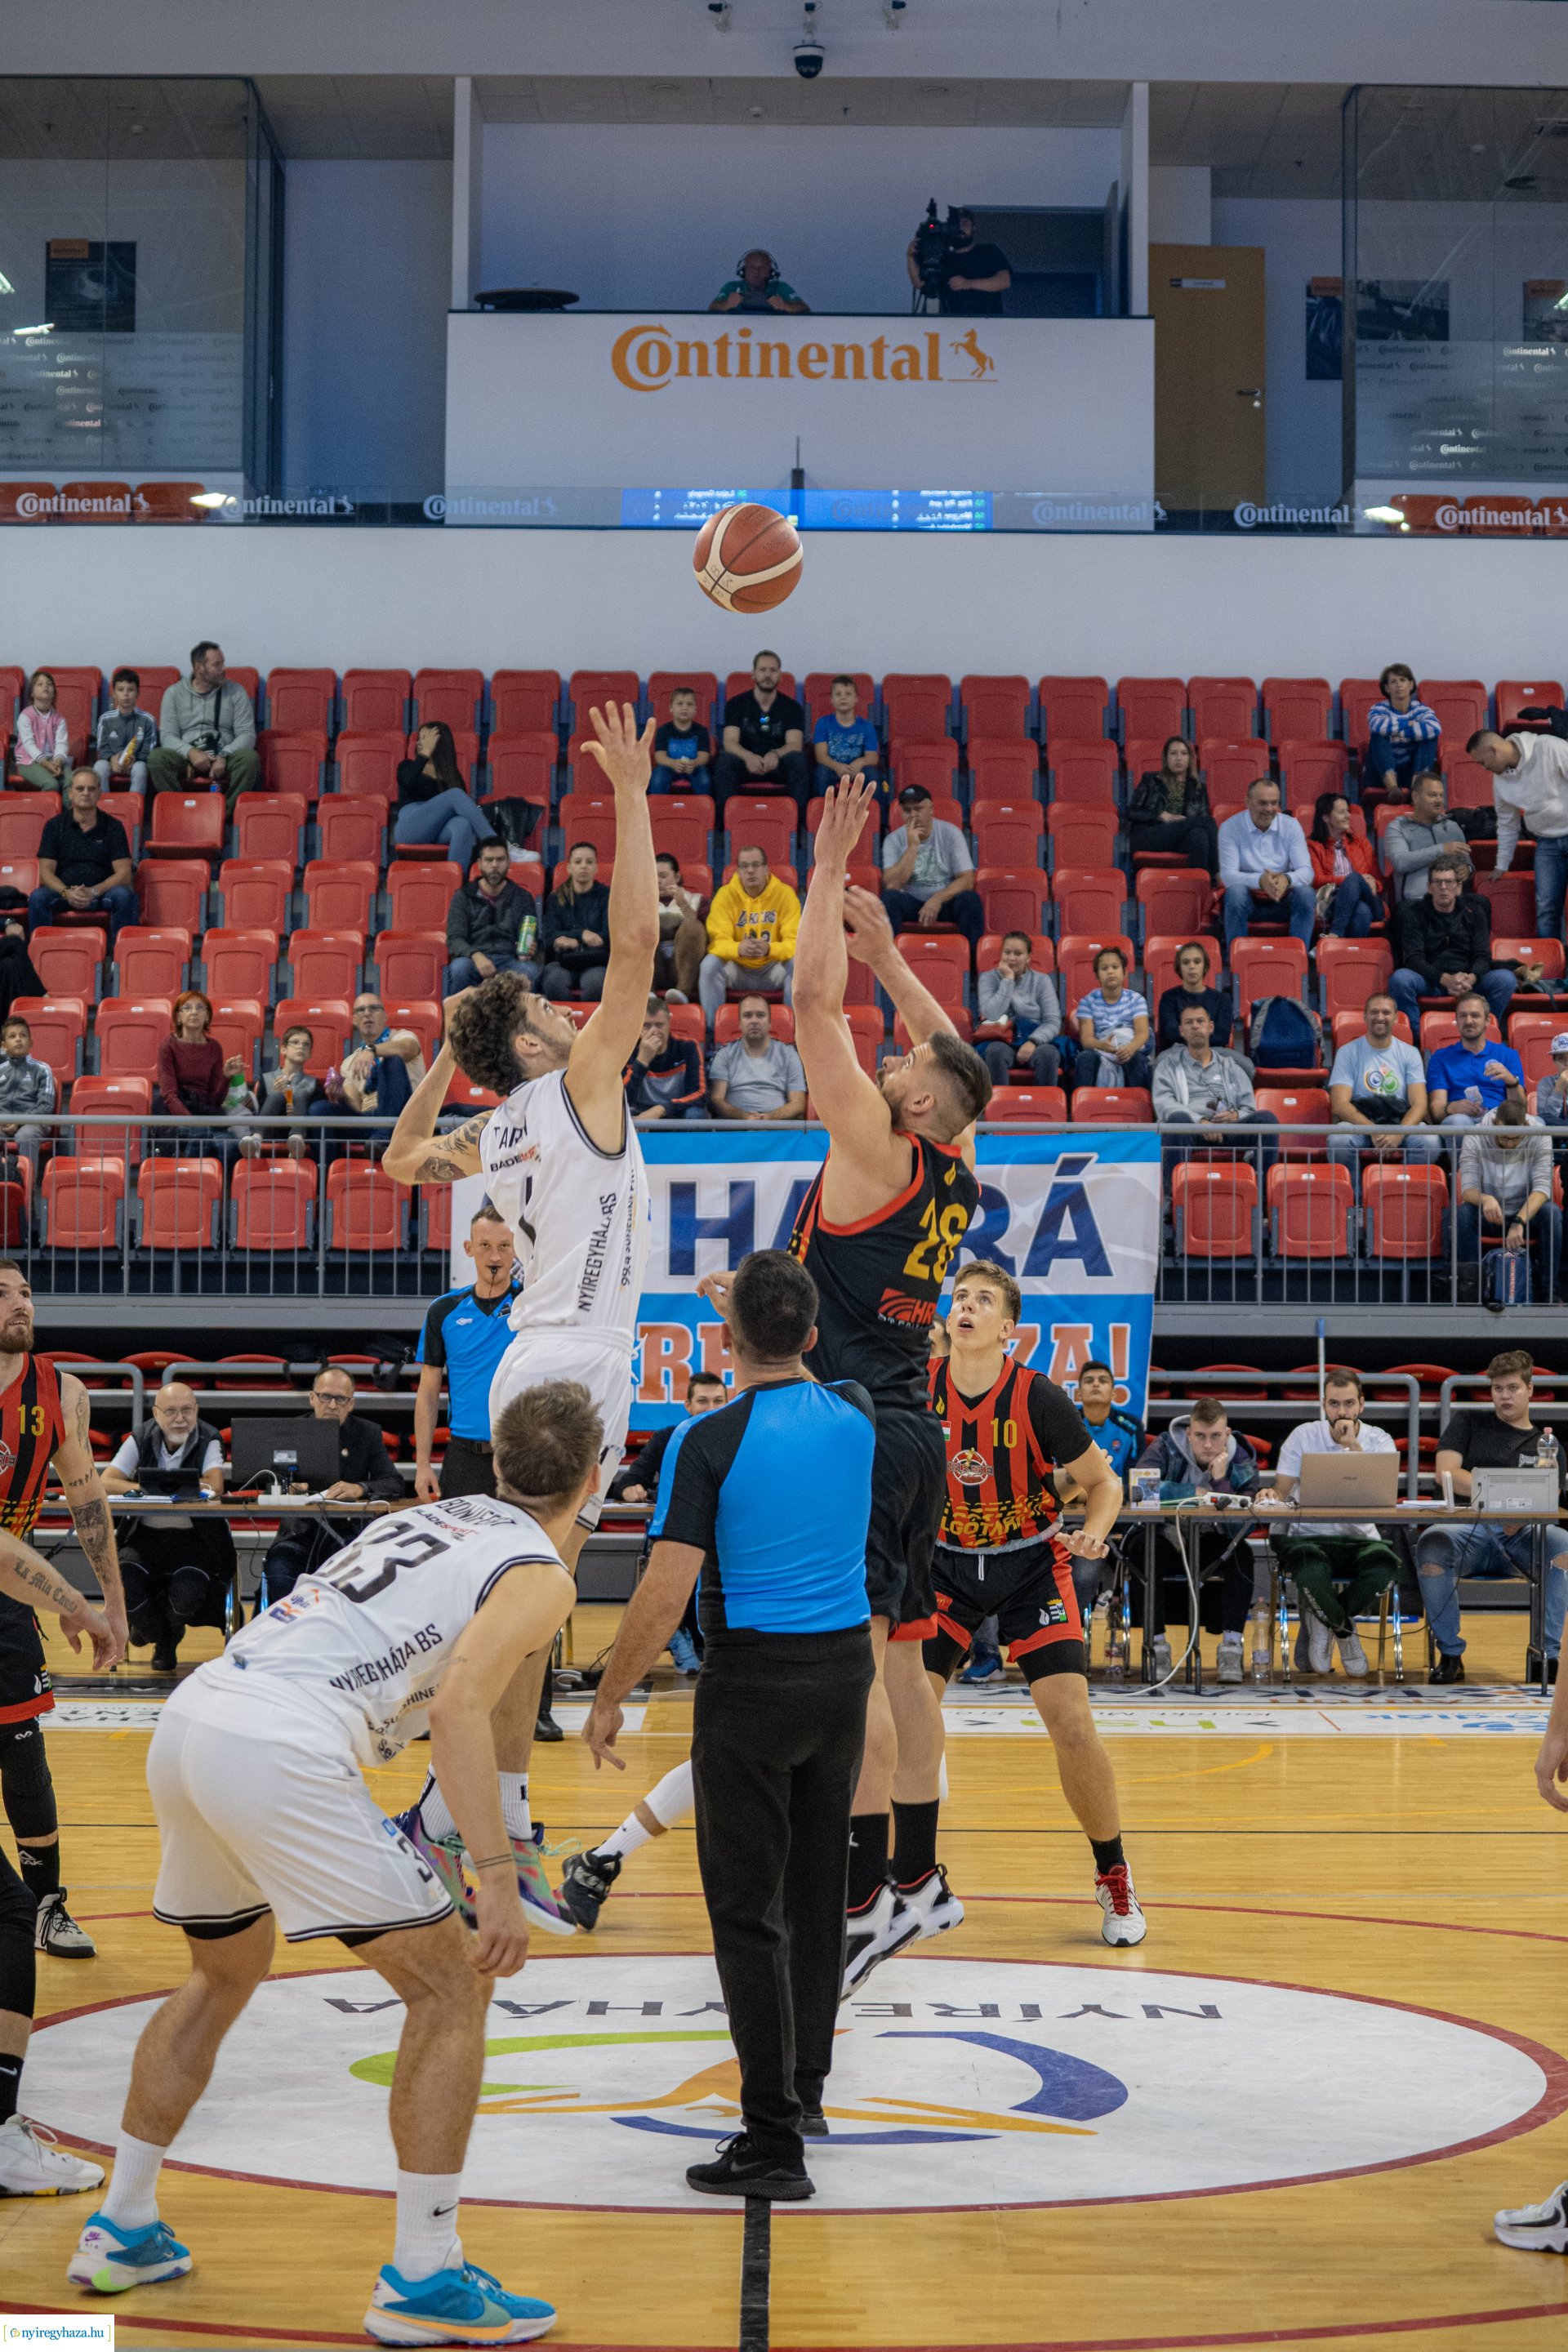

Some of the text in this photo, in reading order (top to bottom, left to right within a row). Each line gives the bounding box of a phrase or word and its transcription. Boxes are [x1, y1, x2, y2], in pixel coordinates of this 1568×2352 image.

[611, 323, 942, 392] Continental
[16, 492, 131, 517] Continental
[1234, 501, 1350, 527] Continental
[1435, 504, 1550, 529] Continental
[17, 1404, 46, 1437] 13
[990, 1417, 1018, 1449] 10
[413, 1623, 443, 1652] BS
